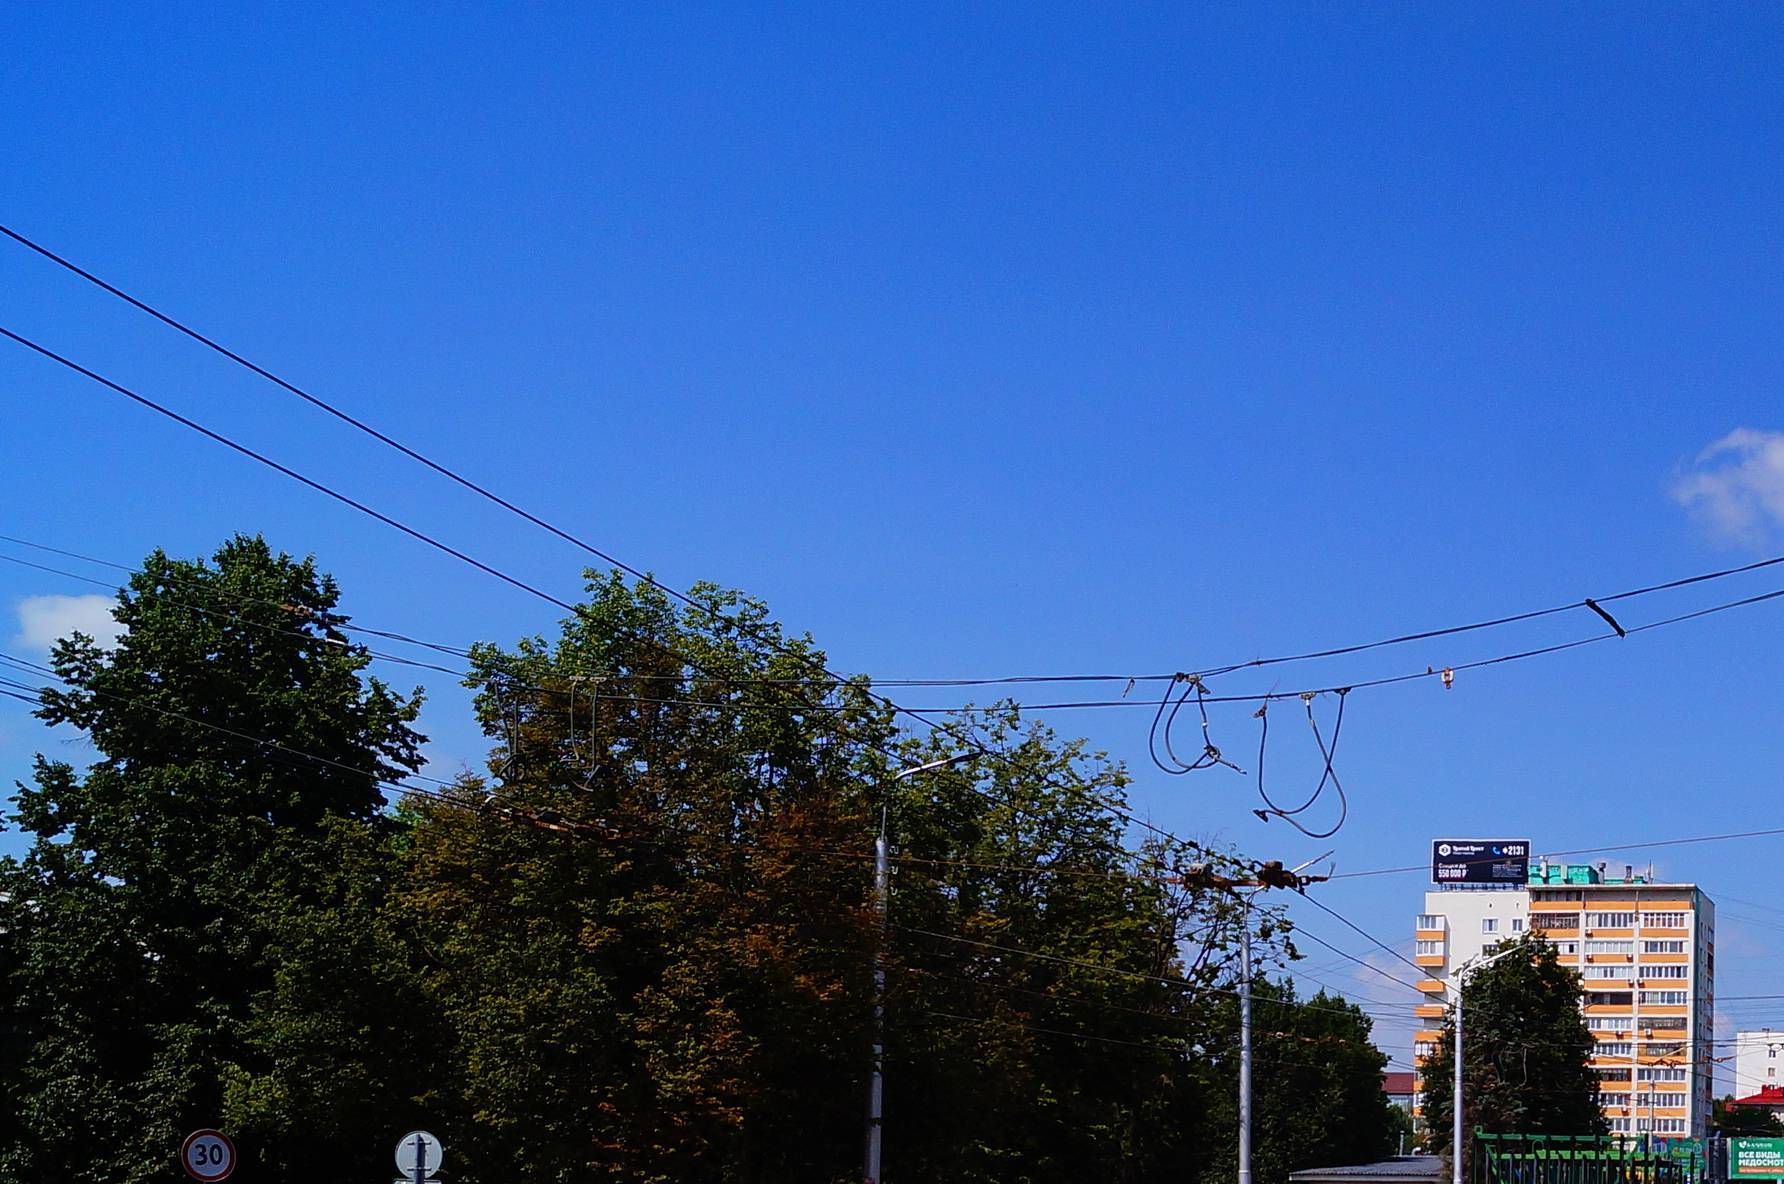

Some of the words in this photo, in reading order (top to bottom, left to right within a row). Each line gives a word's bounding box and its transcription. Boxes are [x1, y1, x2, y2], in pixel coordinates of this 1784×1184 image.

[195, 1144, 223, 1165] 30
[1738, 1151, 1754, 1159] ВСЕ
[1755, 1151, 1781, 1159] ВИДЫ
